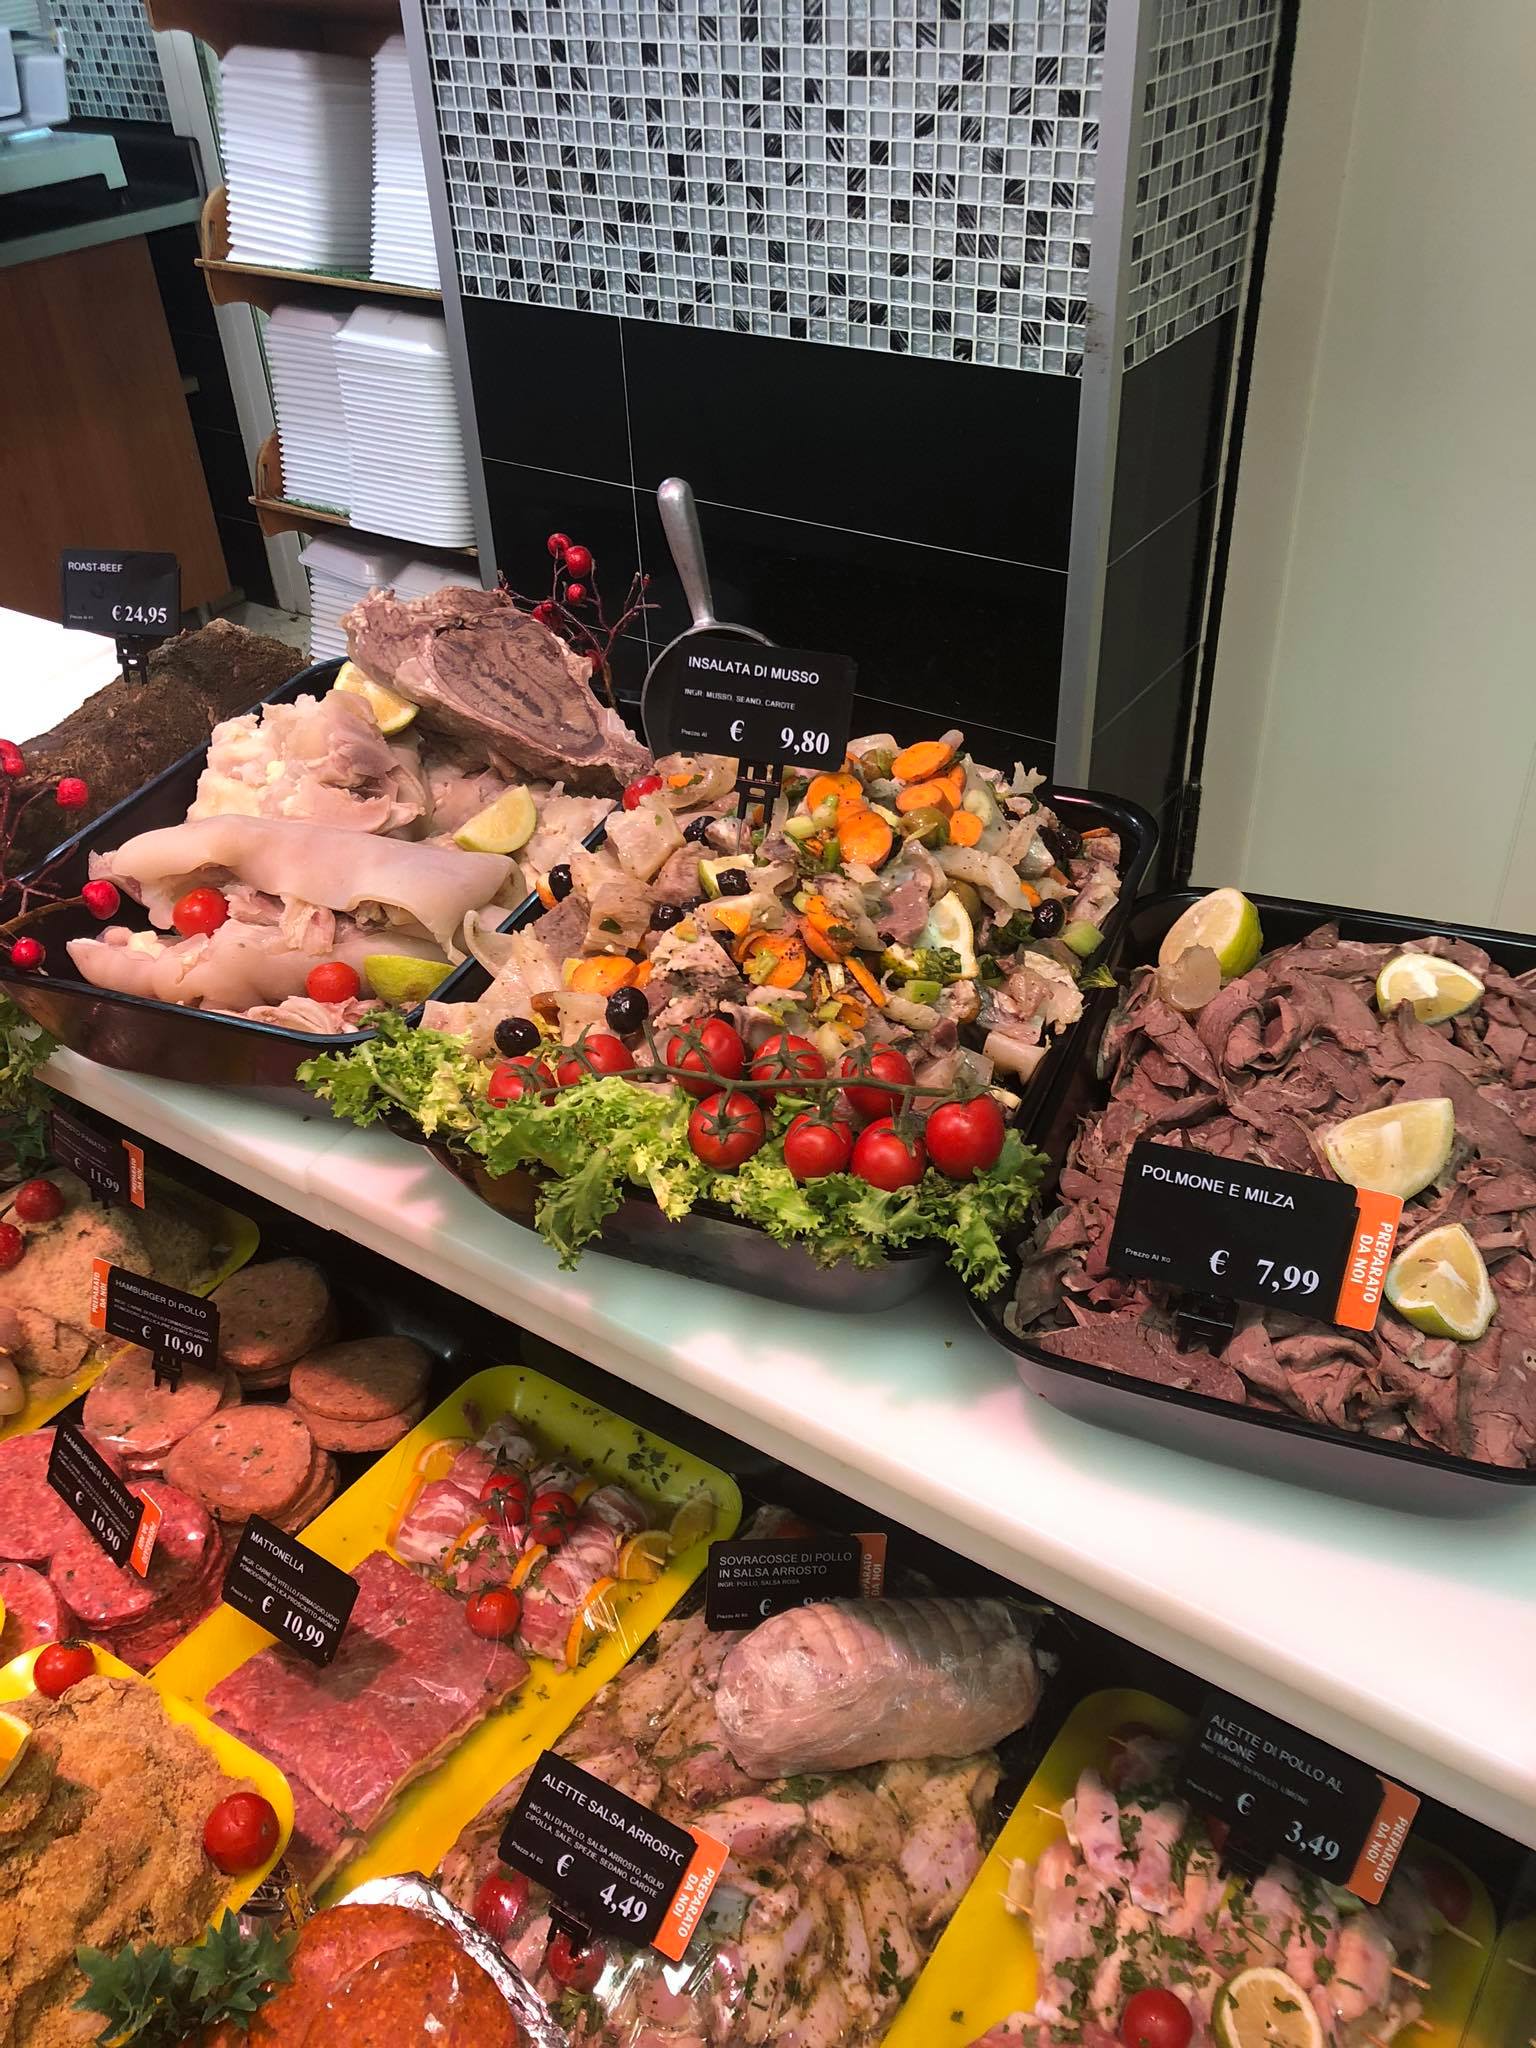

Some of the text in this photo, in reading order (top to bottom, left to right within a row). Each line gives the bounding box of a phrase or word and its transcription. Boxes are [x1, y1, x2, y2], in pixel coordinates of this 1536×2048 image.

[68, 562, 123, 573] ROAST-BEEF
[112, 605, 167, 625] € 24,95
[688, 656, 820, 685] INSALATA DI MUSSO
[730, 719, 830, 755] € 9,80
[91, 1168, 120, 1193] 11,99
[1142, 1164, 1295, 1210] POLMONE E MILZA
[1124, 1247, 1150, 1259] Prezzo
[1209, 1249, 1320, 1295] € 7,99
[1350, 1233, 1374, 1284] DA NOI
[1363, 1221, 1393, 1304] PREPARATO
[91, 1272, 100, 1313] PREPARATO
[115, 1279, 207, 1319] HAMBURGER DI POLLO
[142, 1325, 152, 1339] €
[164, 1333, 203, 1358] 10,90
[63, 1431, 135, 1519] HAMBURGER DI VITELLO
[75, 1491, 121, 1551] € 10,90
[250, 1531, 305, 1574] MATTONELLA
[255, 1563, 272, 1579] CARNE
[719, 1552, 852, 1566] SOVRACOSCE DI POLLO
[719, 1565, 827, 1579] IN SALSA ARROSTO
[871, 1563, 882, 1597] DA NOI
[261, 1595, 325, 1648] € 10,99
[759, 1598, 772, 1616] €
[1205, 1728, 1256, 1764] LIMONE
[1210, 1714, 1344, 1795] ALETTE DI POLLO AL
[541, 1773, 588, 1807] ALETTE
[587, 1799, 626, 1831] SALSA
[1236, 1793, 1340, 1861] € 3,49
[1367, 1821, 1391, 1864] DA NOI
[525, 1811, 658, 1899] CIPOLLA, SALE, SPEZIE, SEDANO, CAROTE
[543, 1811, 555, 1822] ALI
[554, 1817, 562, 1827] DI
[562, 1821, 586, 1842] POLLO,
[586, 1837, 608, 1855] SALSA
[608, 1851, 642, 1877] ARROSTO,
[643, 1872, 665, 1890] AGLIO
[1374, 1816, 1409, 1883] PREPARATO
[557, 1854, 648, 1923] € 4,49
[672, 1873, 699, 1918] DA NOI
[678, 1867, 716, 1938] PREPARATO
